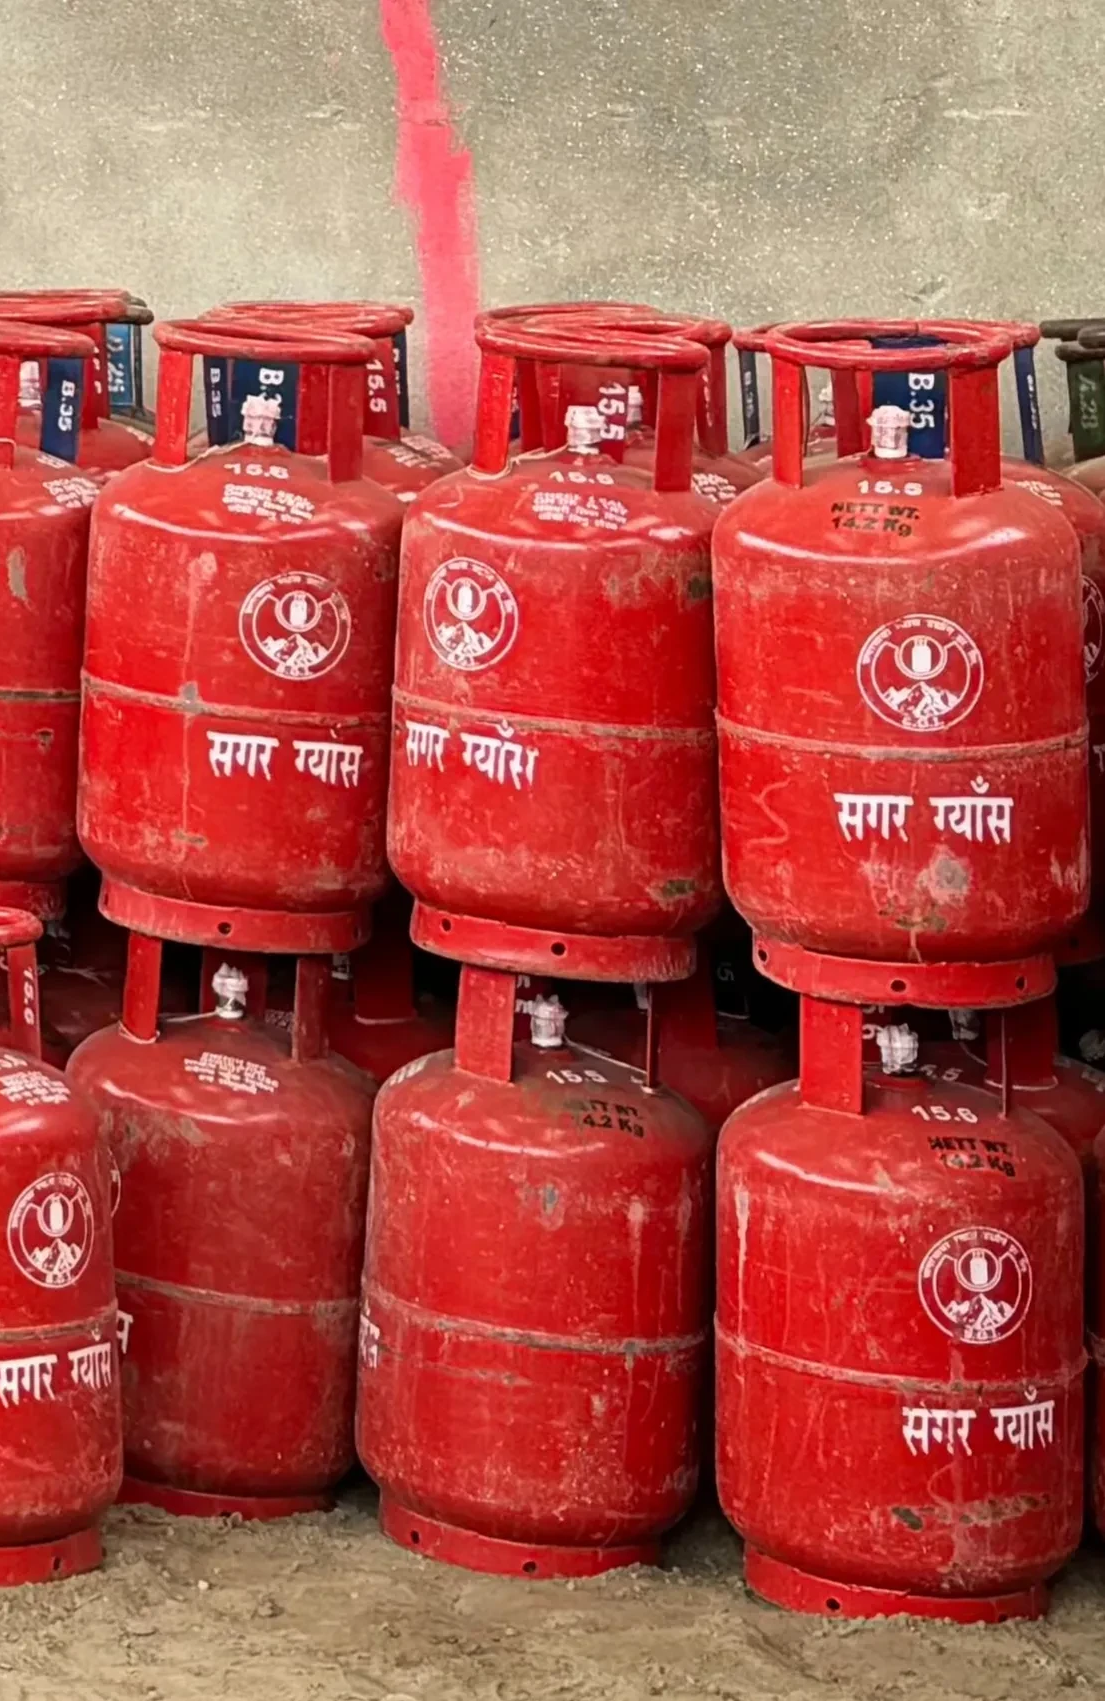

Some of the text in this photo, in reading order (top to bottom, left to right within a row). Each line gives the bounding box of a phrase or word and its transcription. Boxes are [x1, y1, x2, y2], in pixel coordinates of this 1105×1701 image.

[57, 379, 77, 433] B.35
[908, 372, 935, 429] B.35
[206, 730, 280, 782] सगर
[405, 720, 450, 773] सगर
[833, 793, 915, 843] सगर
